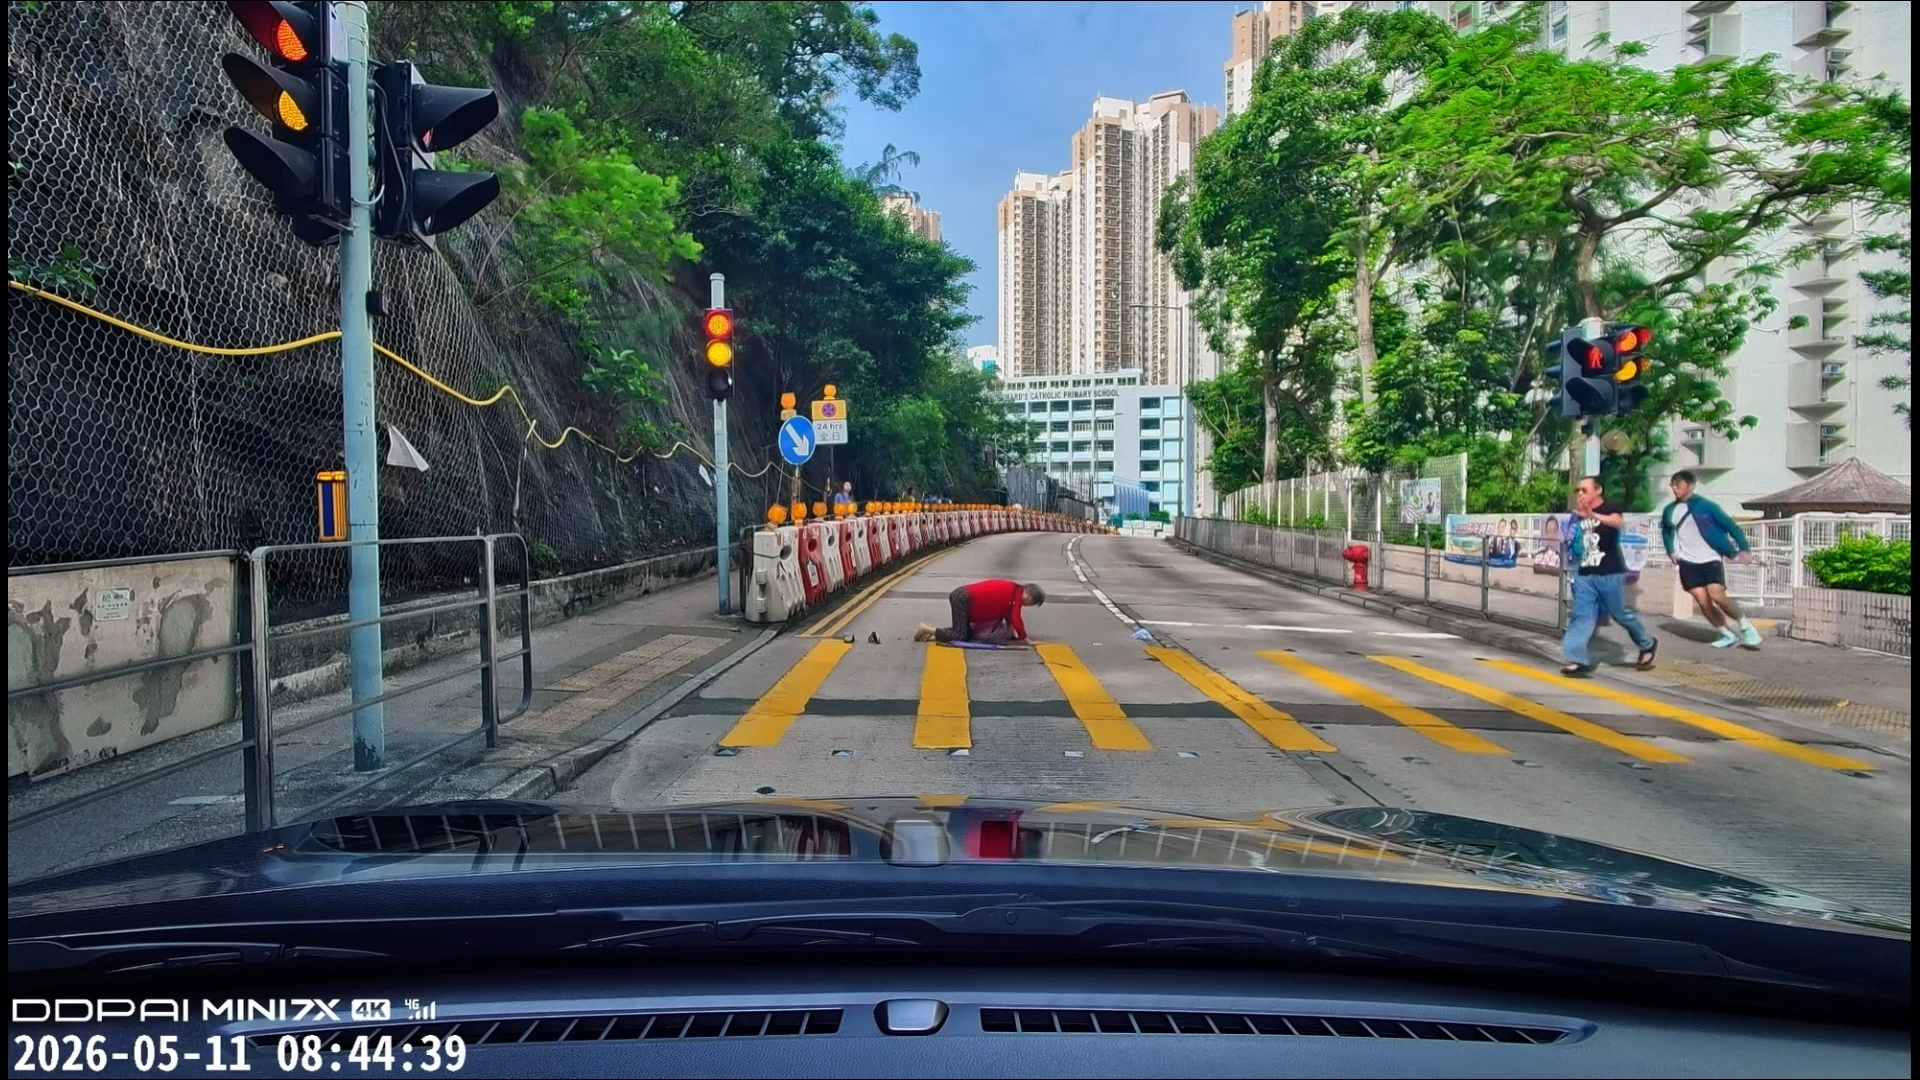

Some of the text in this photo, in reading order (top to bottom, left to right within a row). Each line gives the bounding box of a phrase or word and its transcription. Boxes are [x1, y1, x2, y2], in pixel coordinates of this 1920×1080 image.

[1030, 391, 1062, 400] CATHOLIC
[1063, 390, 1092, 399] PRIMARY
[1093, 389, 1120, 397] SCHOOL
[820, 432, 840, 441] 全日
